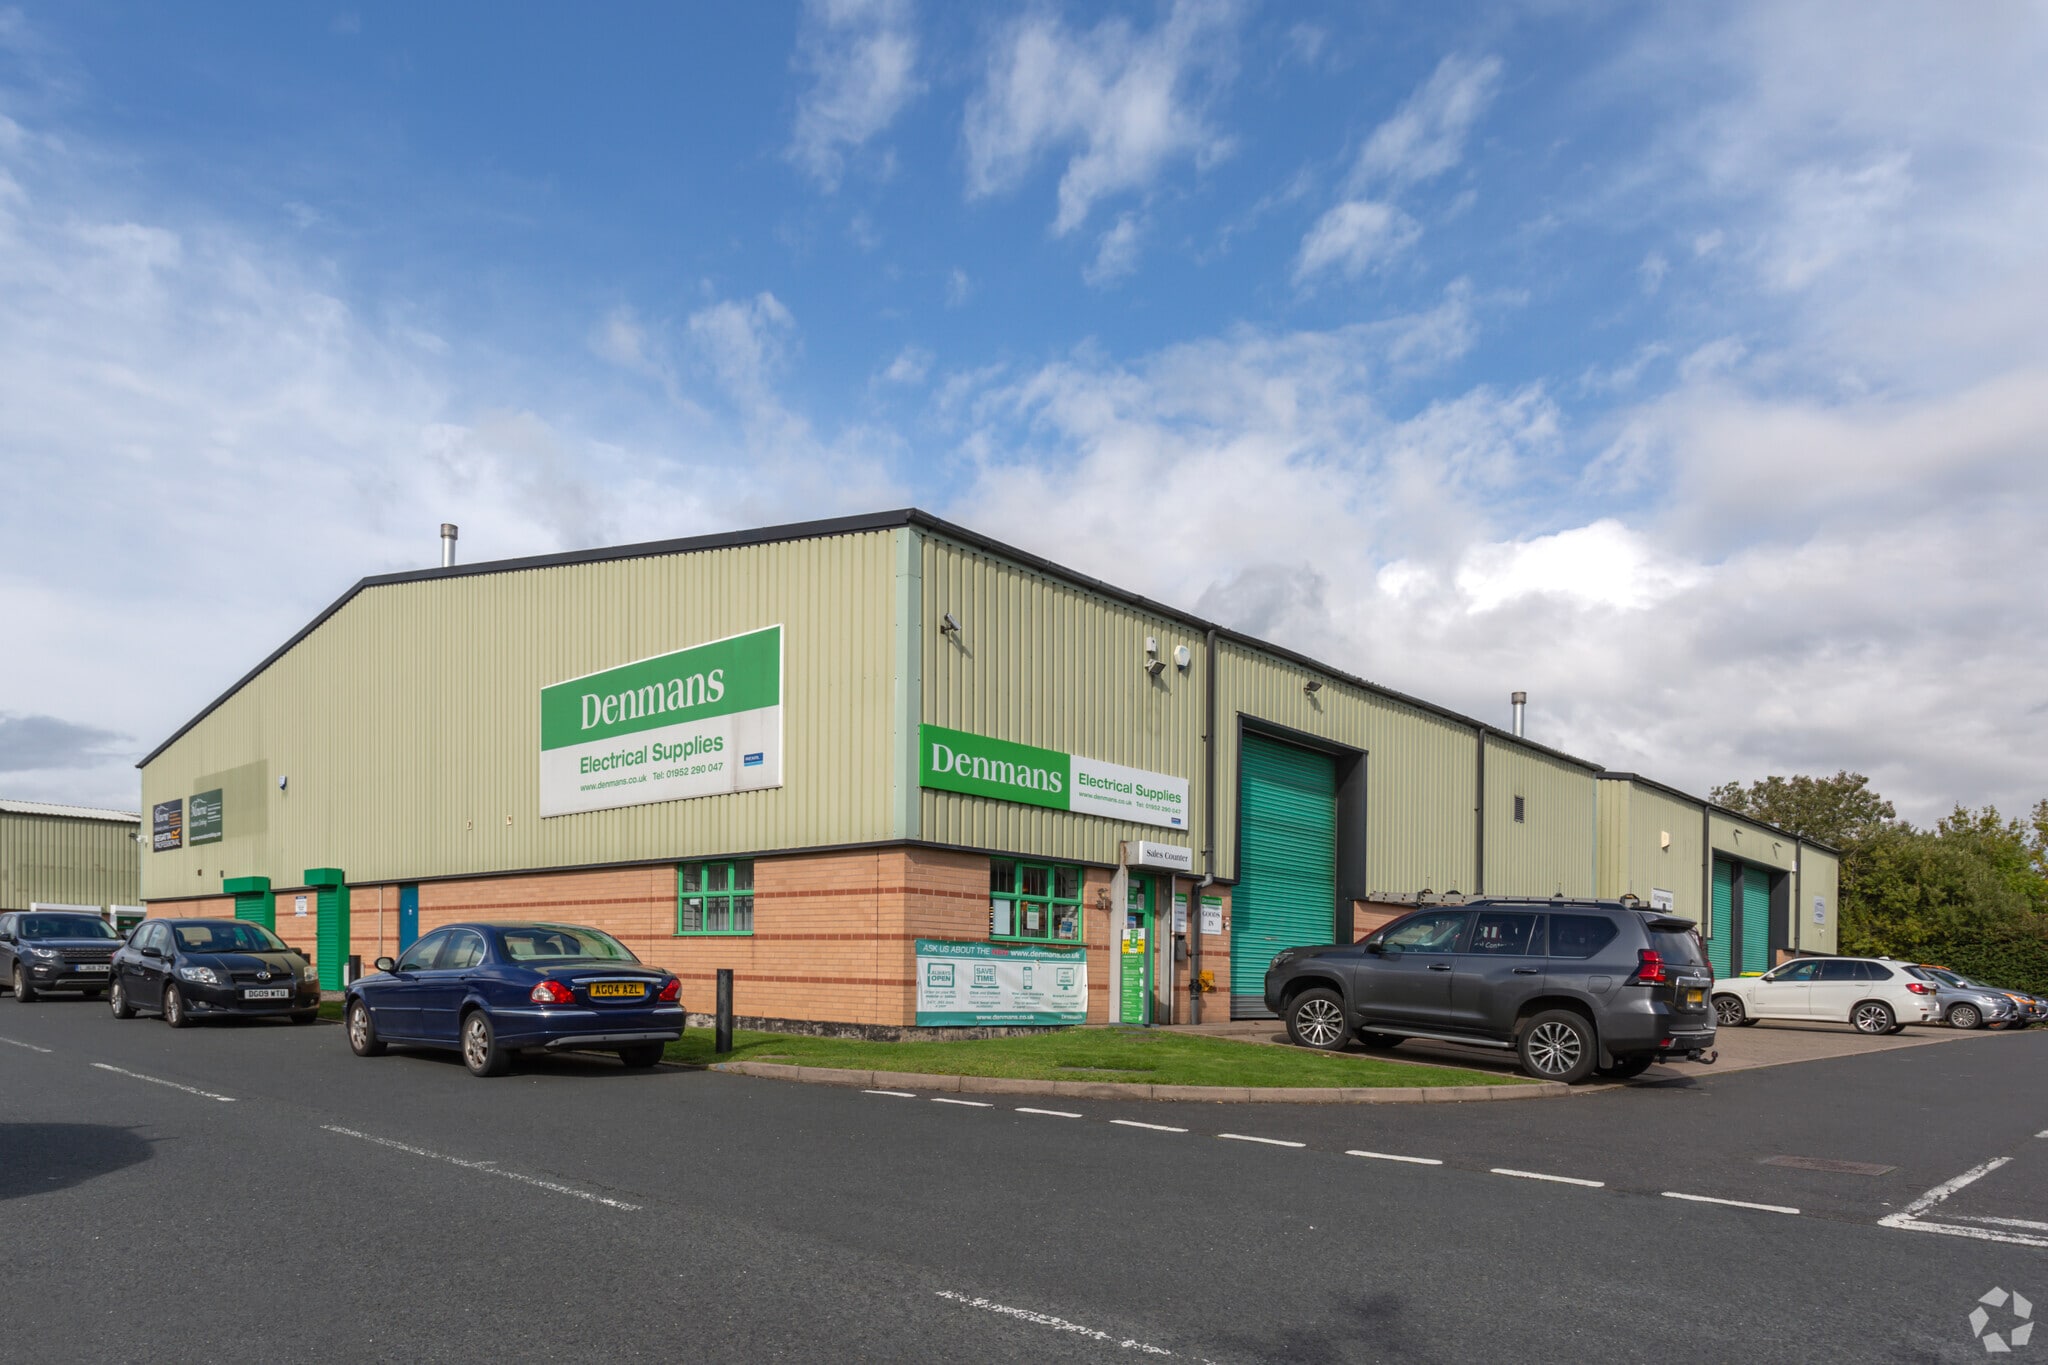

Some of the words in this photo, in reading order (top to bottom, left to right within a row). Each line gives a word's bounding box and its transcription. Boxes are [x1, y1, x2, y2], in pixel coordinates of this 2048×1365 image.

[580, 668, 725, 730] Denmans
[580, 745, 648, 774] Electrical
[652, 735, 724, 763] Supplies
[931, 743, 1063, 793] Denmans
[580, 774, 647, 792] www.denmans.co.uk
[652, 771, 665, 781] Tel:
[666, 767, 689, 779] 01952
[690, 764, 706, 775] 290
[707, 762, 724, 773] 047
[1078, 772, 1133, 794] Electrical
[1136, 784, 1182, 804] Supplies
[1079, 792, 1132, 806] www.denmans.co.uk
[1146, 849, 1163, 858] Sales
[1164, 851, 1188, 862] Counter
[923, 944, 938, 953] ASK
[940, 945, 949, 953] US
[950, 946, 975, 954] ABOUT
[977, 947, 990, 955] THE
[1010, 950, 1080, 959] www.denmans.co.uk
